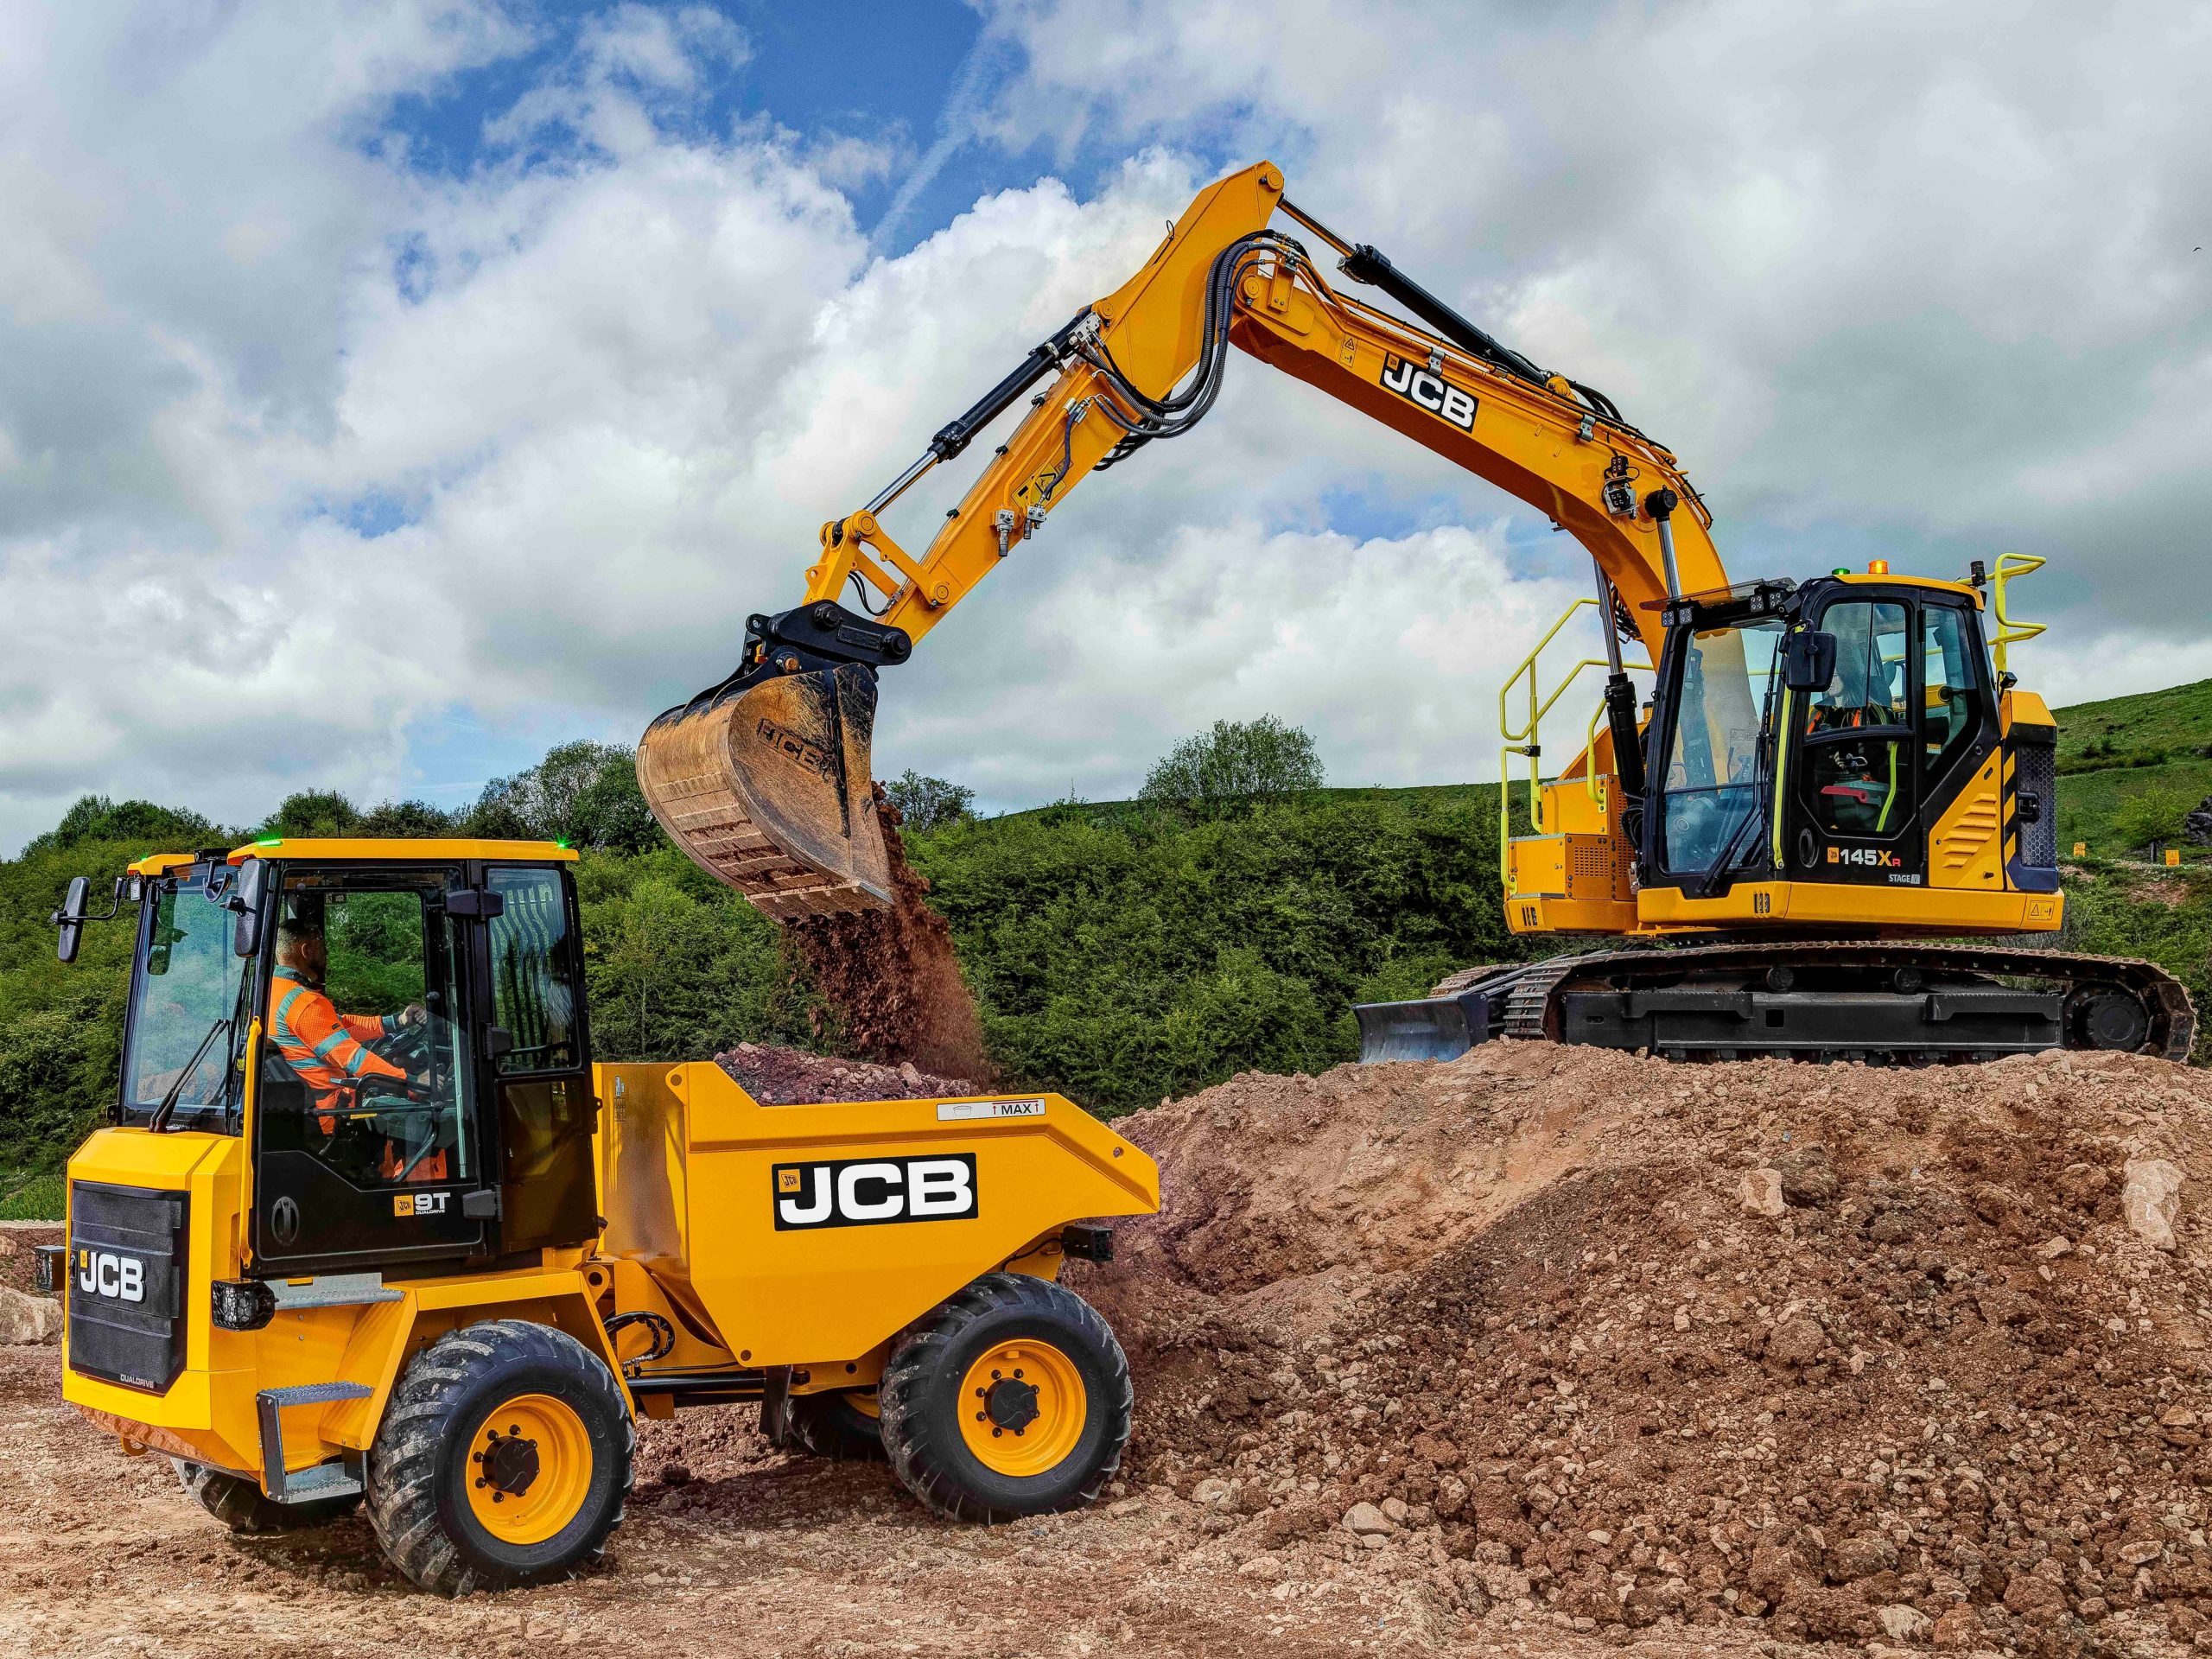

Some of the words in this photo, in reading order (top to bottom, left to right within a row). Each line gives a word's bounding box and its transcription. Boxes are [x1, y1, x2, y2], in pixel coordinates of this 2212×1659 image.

[1384, 362, 1475, 428] JCB
[1889, 874, 1910, 883] STAGE
[1001, 1103, 1032, 1115] MAX
[783, 1174, 798, 1187] JCB
[780, 1160, 973, 1224] JCB
[415, 1192, 451, 1211] 9T
[80, 1251, 143, 1302] JCB
[121, 1374, 154, 1389] DUALDRIVE
